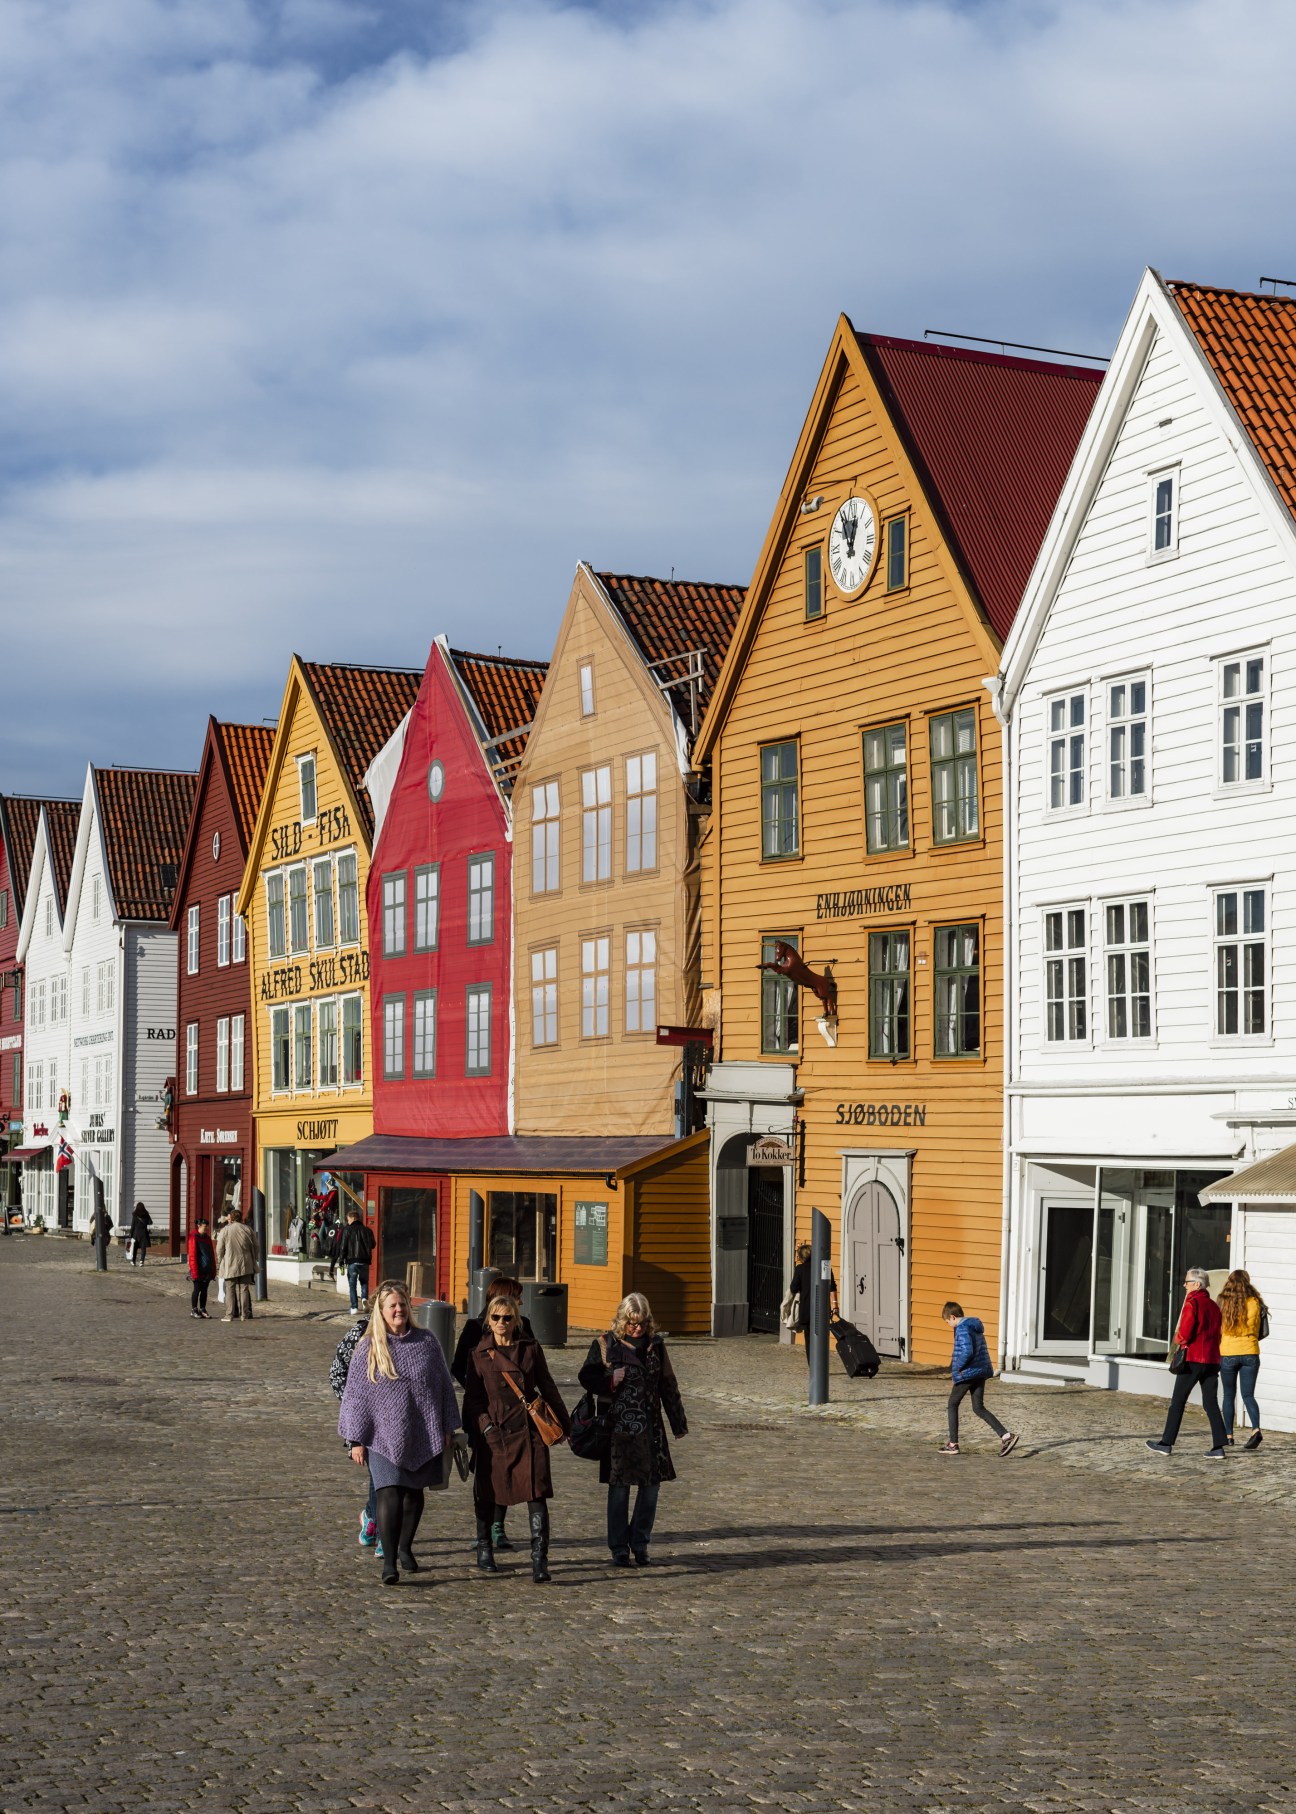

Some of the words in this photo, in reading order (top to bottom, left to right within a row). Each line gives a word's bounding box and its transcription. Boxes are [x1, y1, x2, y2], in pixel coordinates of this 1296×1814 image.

[271, 821, 302, 861] SILD
[816, 883, 912, 919] ENHJØRNINGEN
[261, 965, 302, 1001] ALFRED
[309, 950, 370, 991] SKULSTAD
[147, 1028, 176, 1040] RAD
[835, 1103, 927, 1126] SJØBODEN
[296, 1119, 339, 1141] SCHJØTT
[750, 1148, 761, 1160] To
[761, 1148, 792, 1160] Kokker
